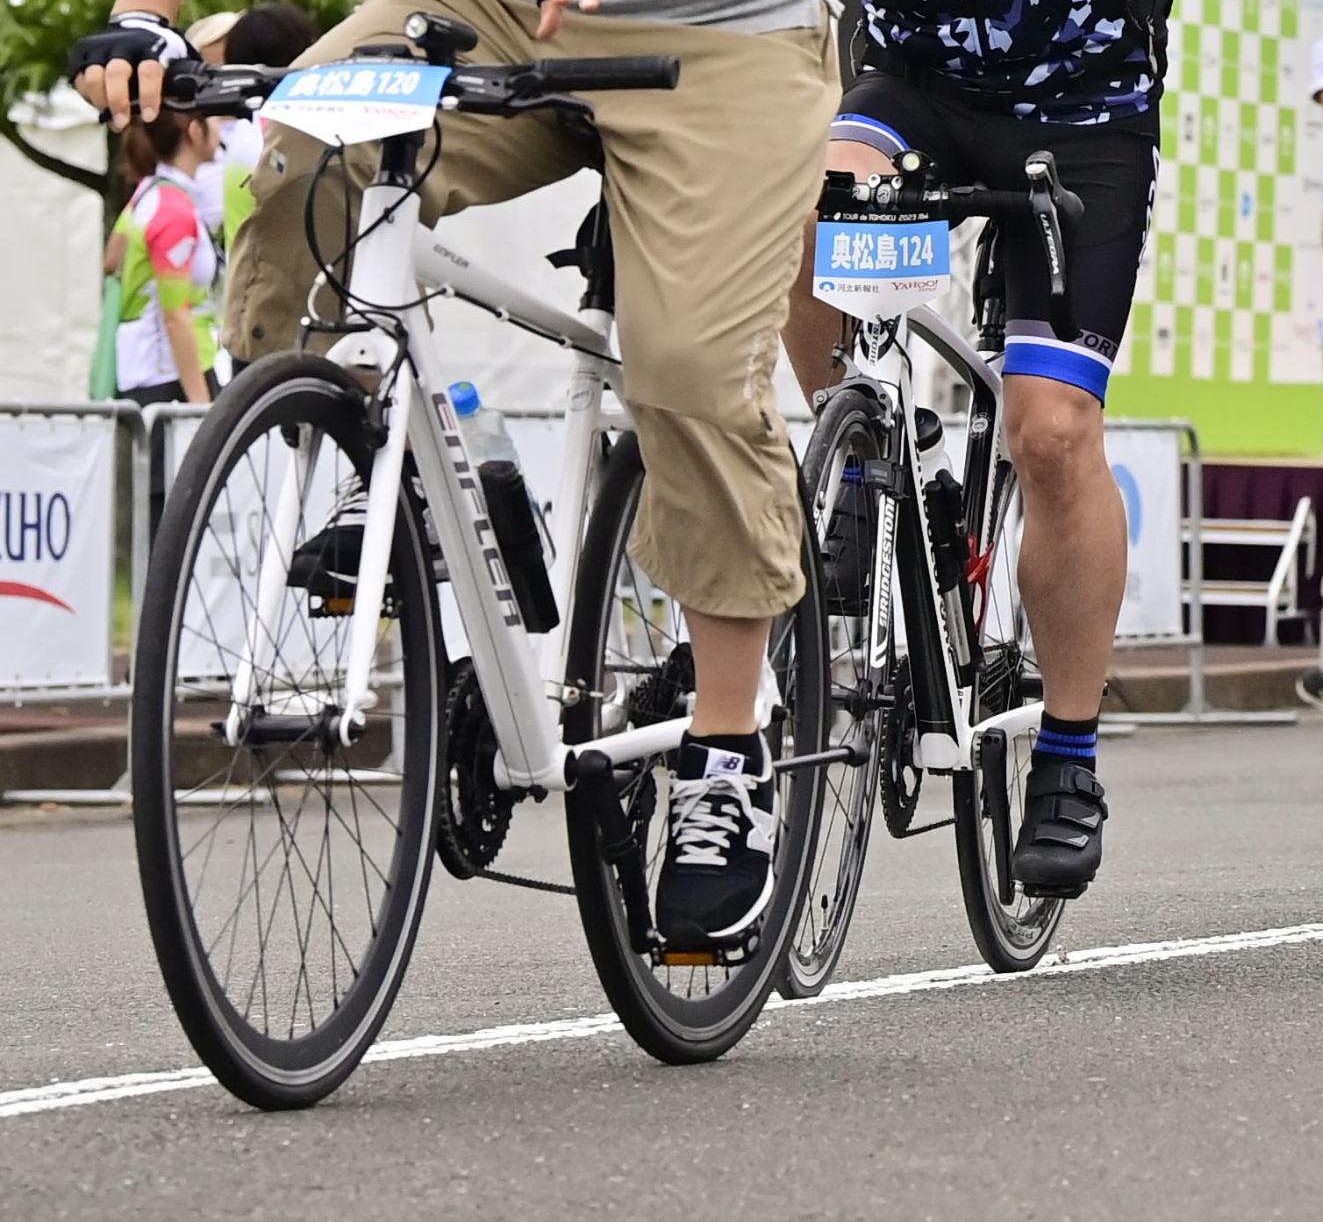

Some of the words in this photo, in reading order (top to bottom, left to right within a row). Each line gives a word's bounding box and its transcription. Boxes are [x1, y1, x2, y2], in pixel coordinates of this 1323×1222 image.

[831, 232, 934, 271] 奥松島124
[0, 491, 71, 561] UHO
